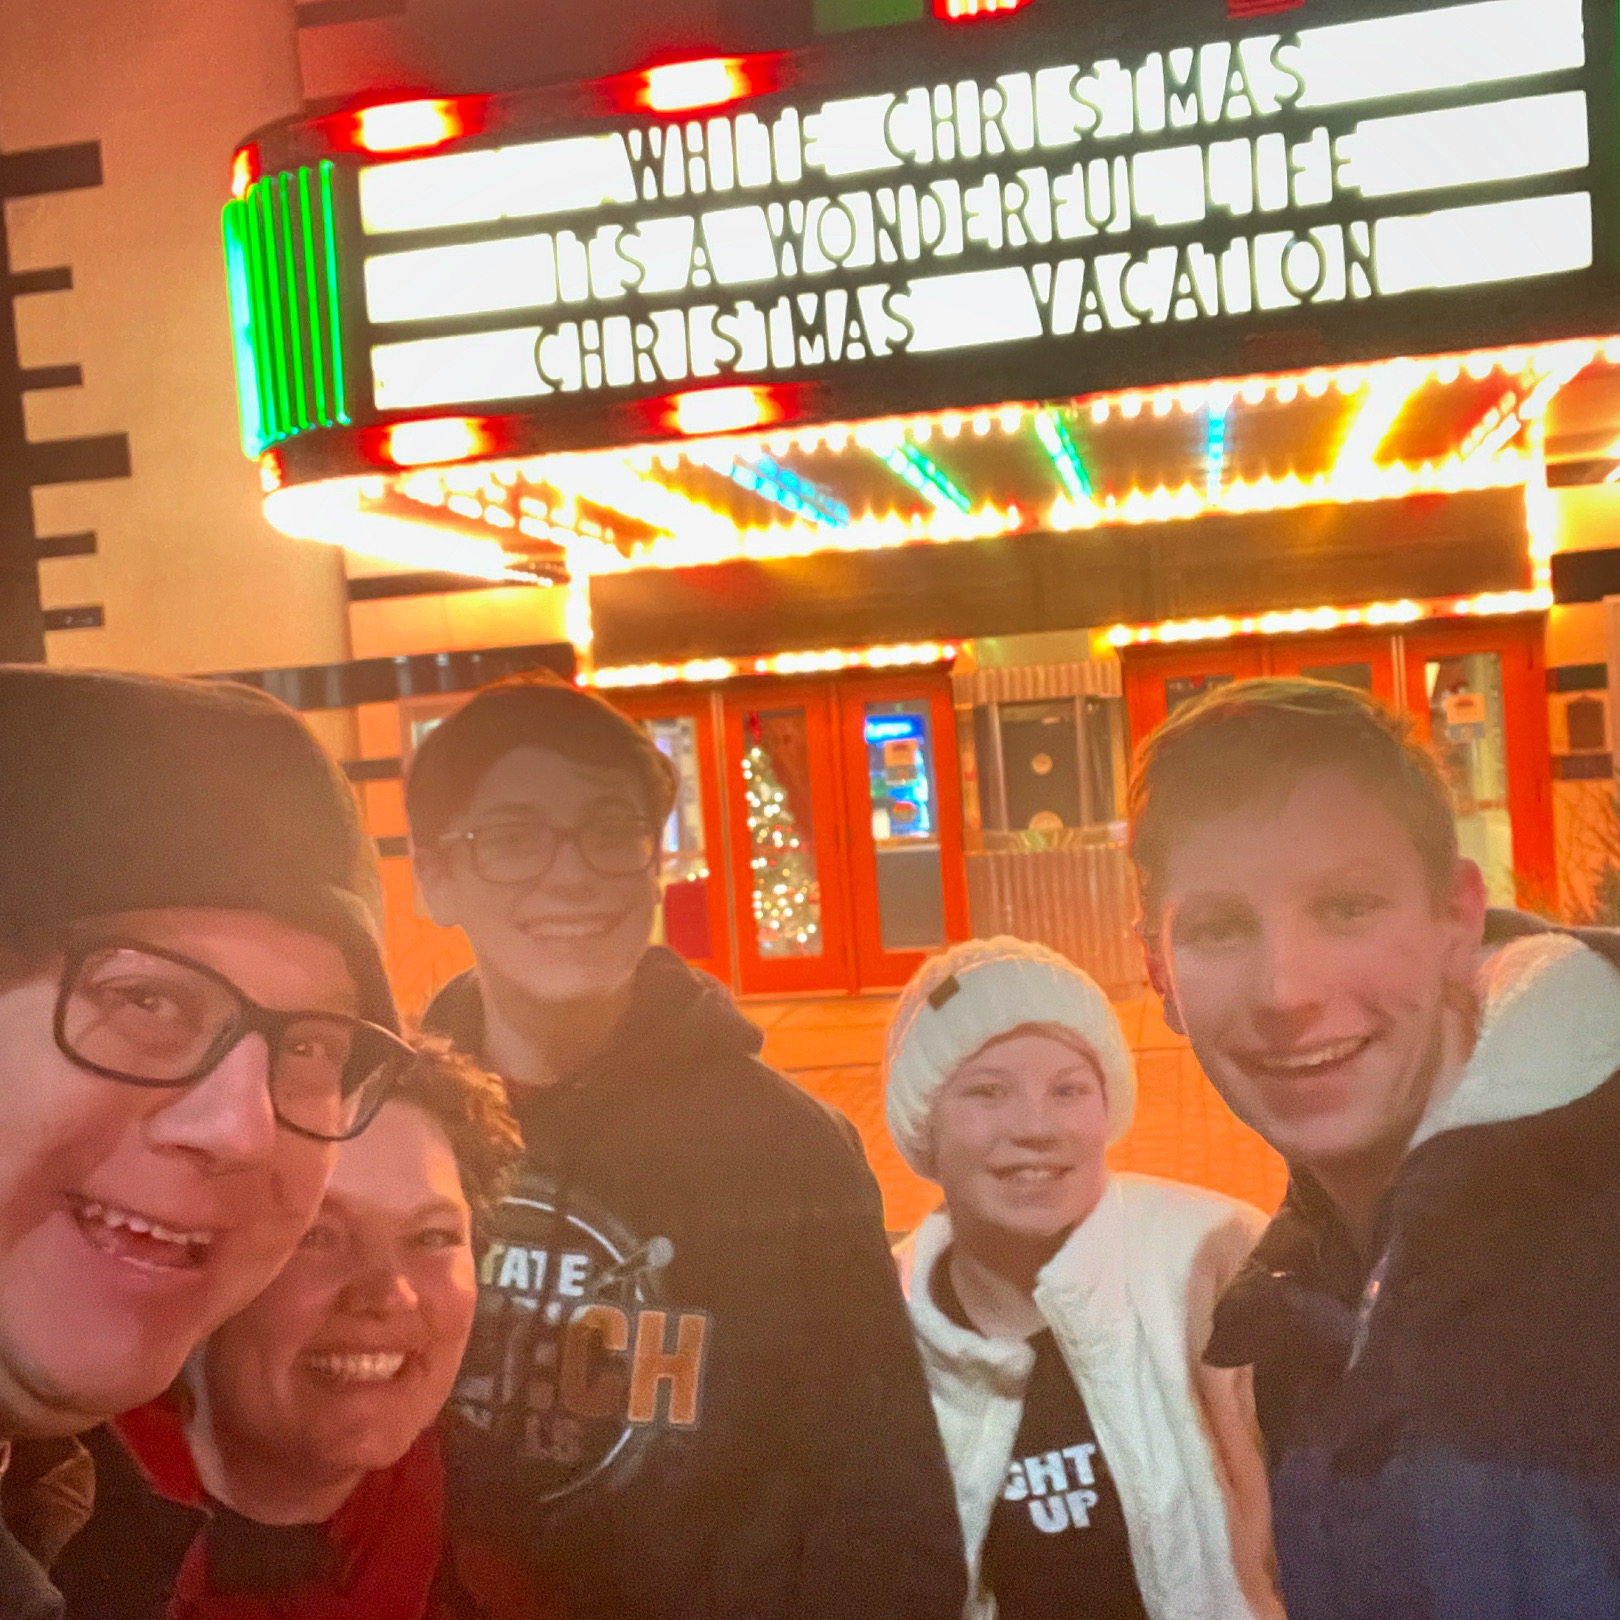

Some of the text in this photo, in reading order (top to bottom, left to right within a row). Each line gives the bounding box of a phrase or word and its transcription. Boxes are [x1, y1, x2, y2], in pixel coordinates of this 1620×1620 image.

[620, 34, 1306, 202] WHITE CHRISTMAS
[552, 130, 1362, 303] ITS A WONDERFUL LIFE
[534, 219, 1381, 393] CHRISTMAS VACATION
[1028, 1490, 1098, 1533] UP
